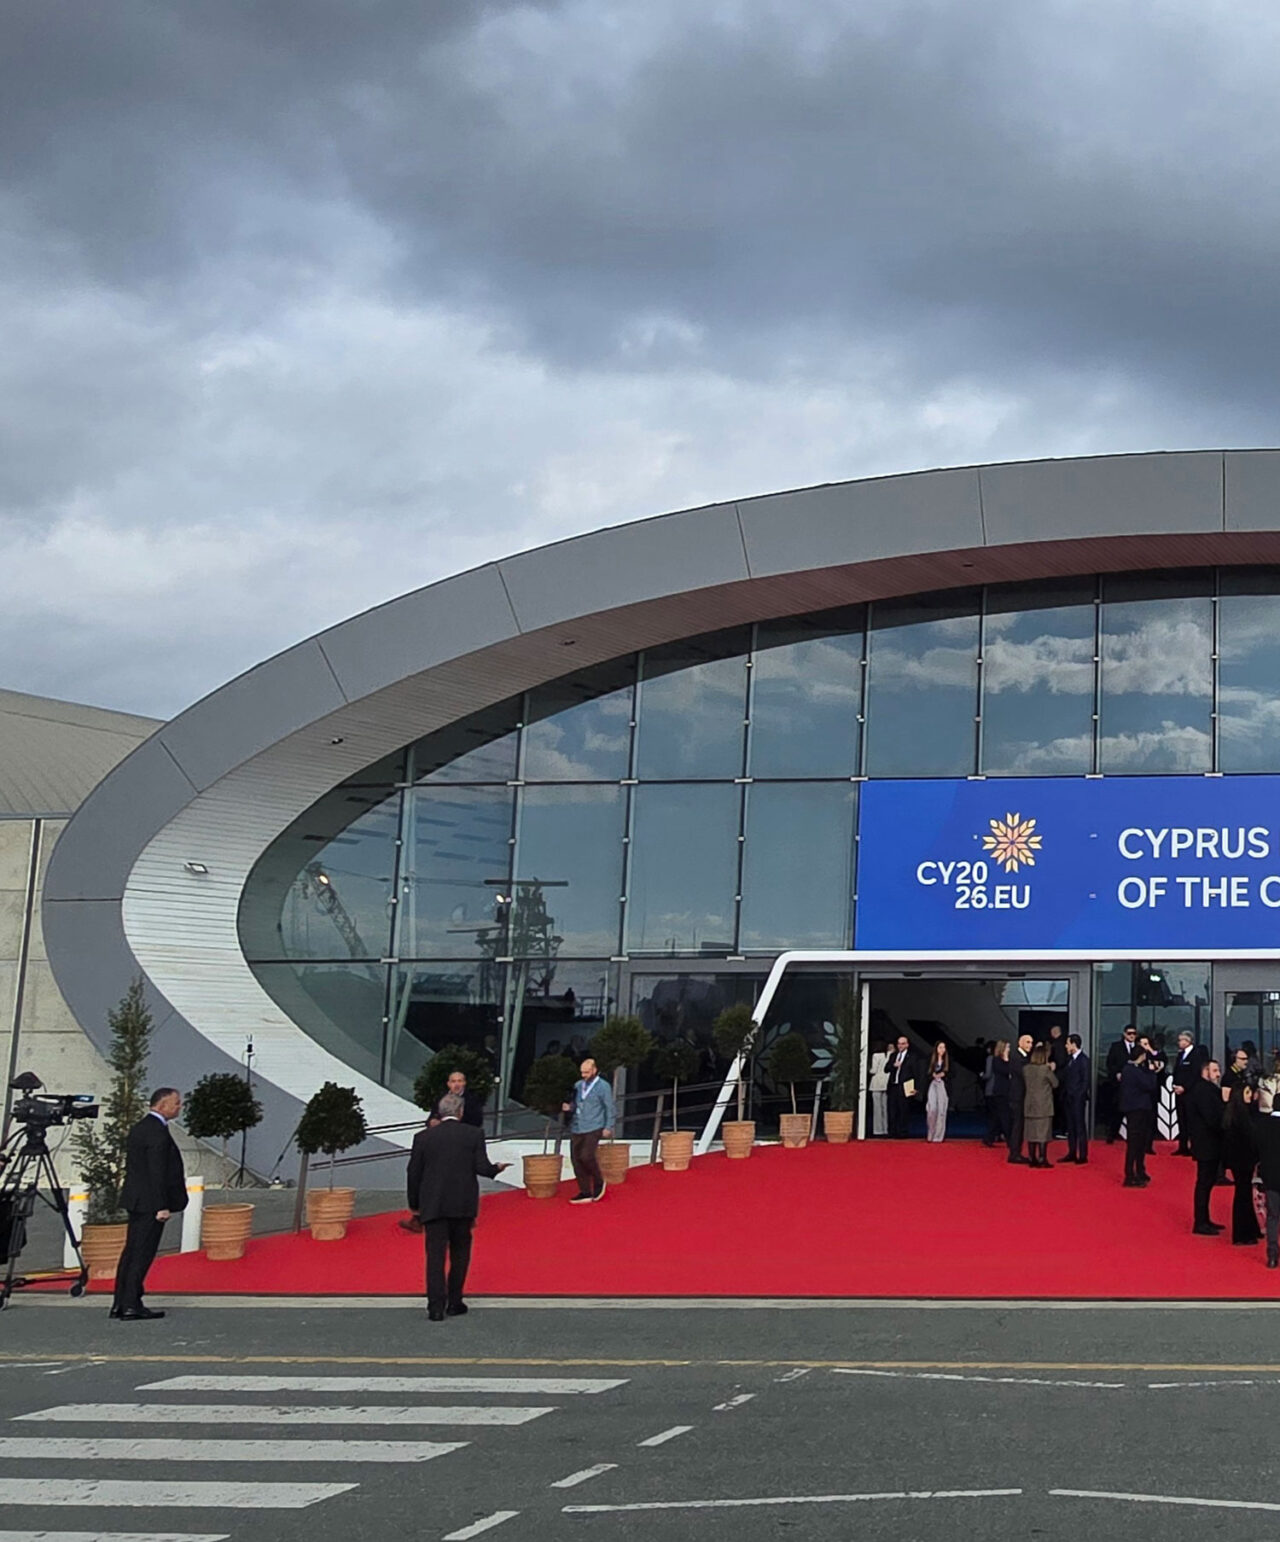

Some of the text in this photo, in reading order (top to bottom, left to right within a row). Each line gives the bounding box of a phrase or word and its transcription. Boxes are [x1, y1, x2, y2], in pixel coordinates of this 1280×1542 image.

[1119, 827, 1270, 858] CYPRUS
[916, 861, 988, 885] CY20
[954, 886, 1031, 909] 26.EU
[1118, 877, 1168, 908] OF
[1176, 877, 1250, 908] THE
